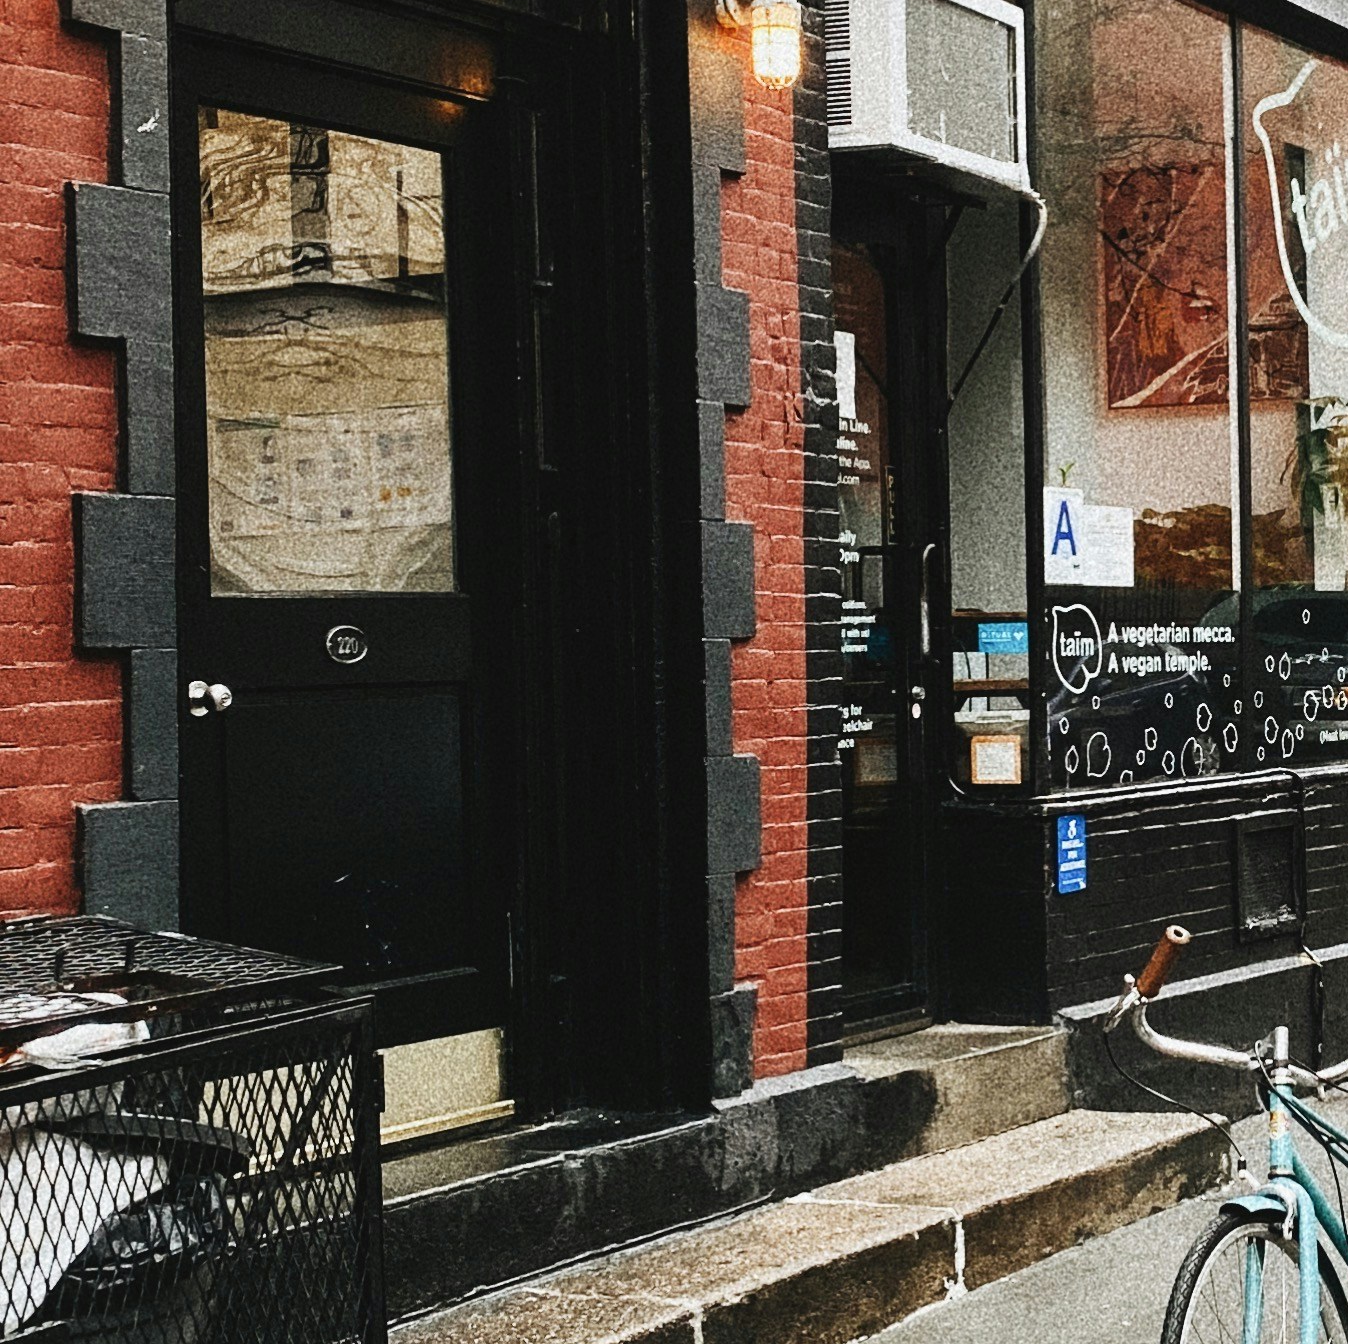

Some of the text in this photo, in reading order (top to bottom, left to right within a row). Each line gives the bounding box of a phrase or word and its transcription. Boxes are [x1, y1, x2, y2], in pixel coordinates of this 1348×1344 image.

[1051, 500, 1077, 556] A
[337, 636, 359, 654] 220
[1107, 621, 1236, 647] A vegetarian mecca.
[1107, 650, 1212, 677] A vegan temple.
